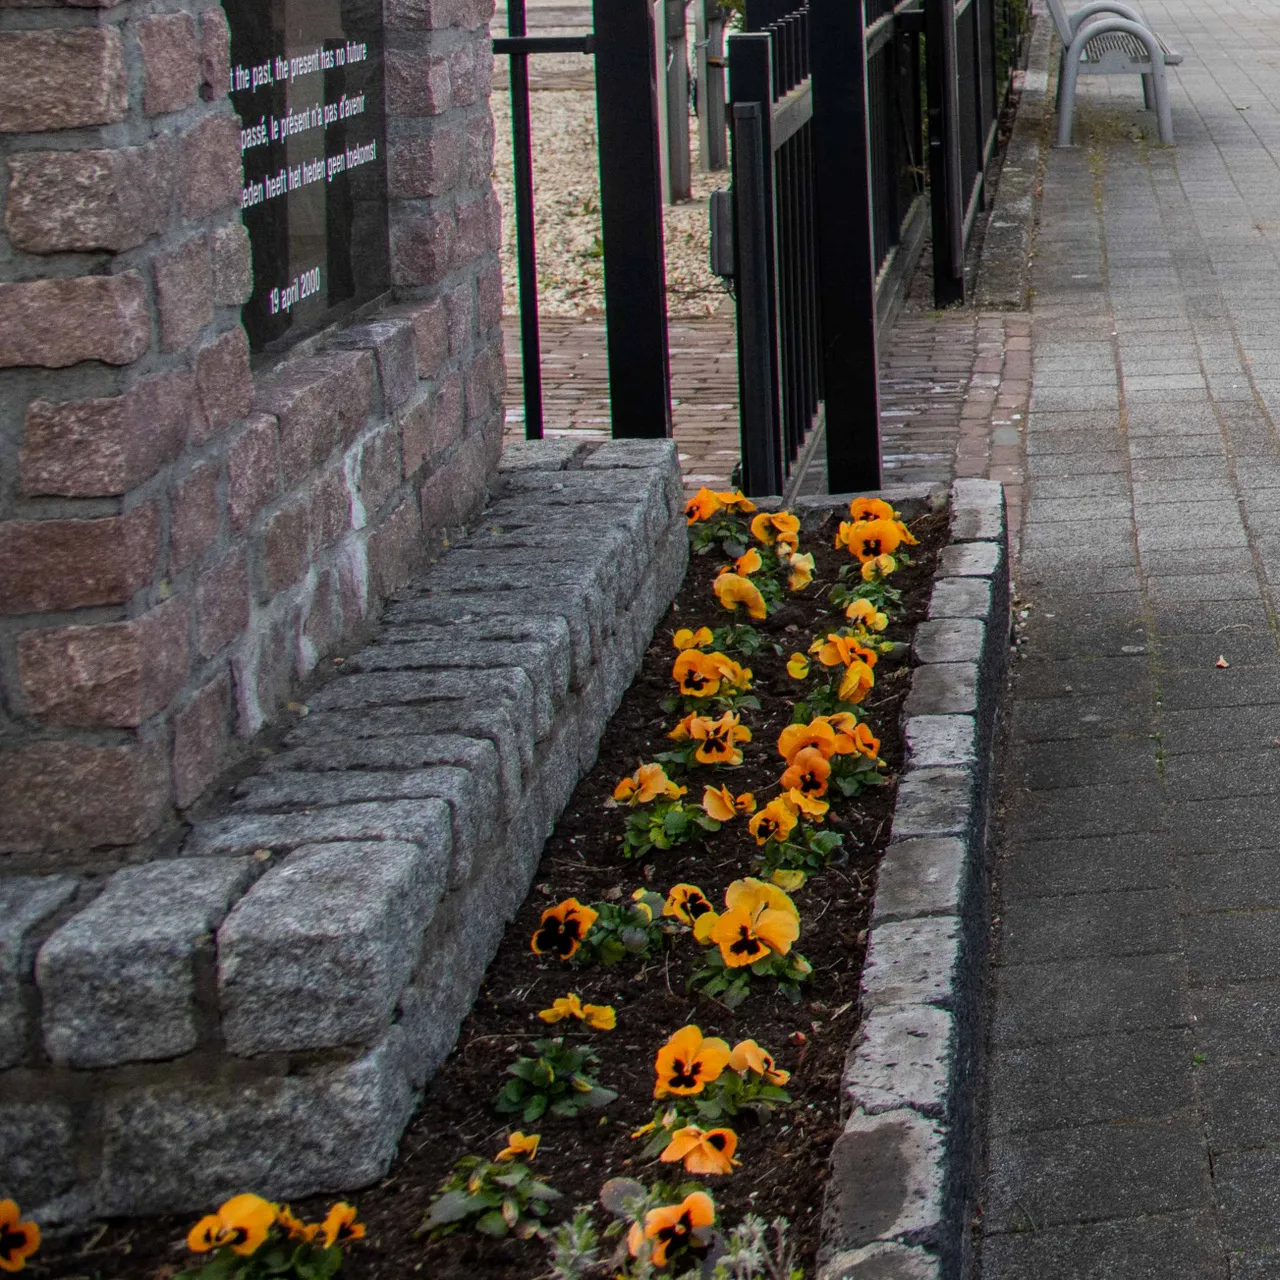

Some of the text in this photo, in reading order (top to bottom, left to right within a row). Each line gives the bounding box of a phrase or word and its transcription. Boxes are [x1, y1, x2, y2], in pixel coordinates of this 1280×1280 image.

[236, 64, 251, 91] the
[252, 59, 274, 93] past,
[275, 55, 289, 81] the
[290, 48, 320, 83] present
[320, 46, 334, 70] has
[335, 47, 346, 66] no
[346, 40, 367, 64] future
[240, 90, 365, 157] passé, le présent n'a pas d'avenir
[241, 138, 377, 208] eden heeft het heden geen toekomst
[269, 266, 321, 315] 19 april 2000
